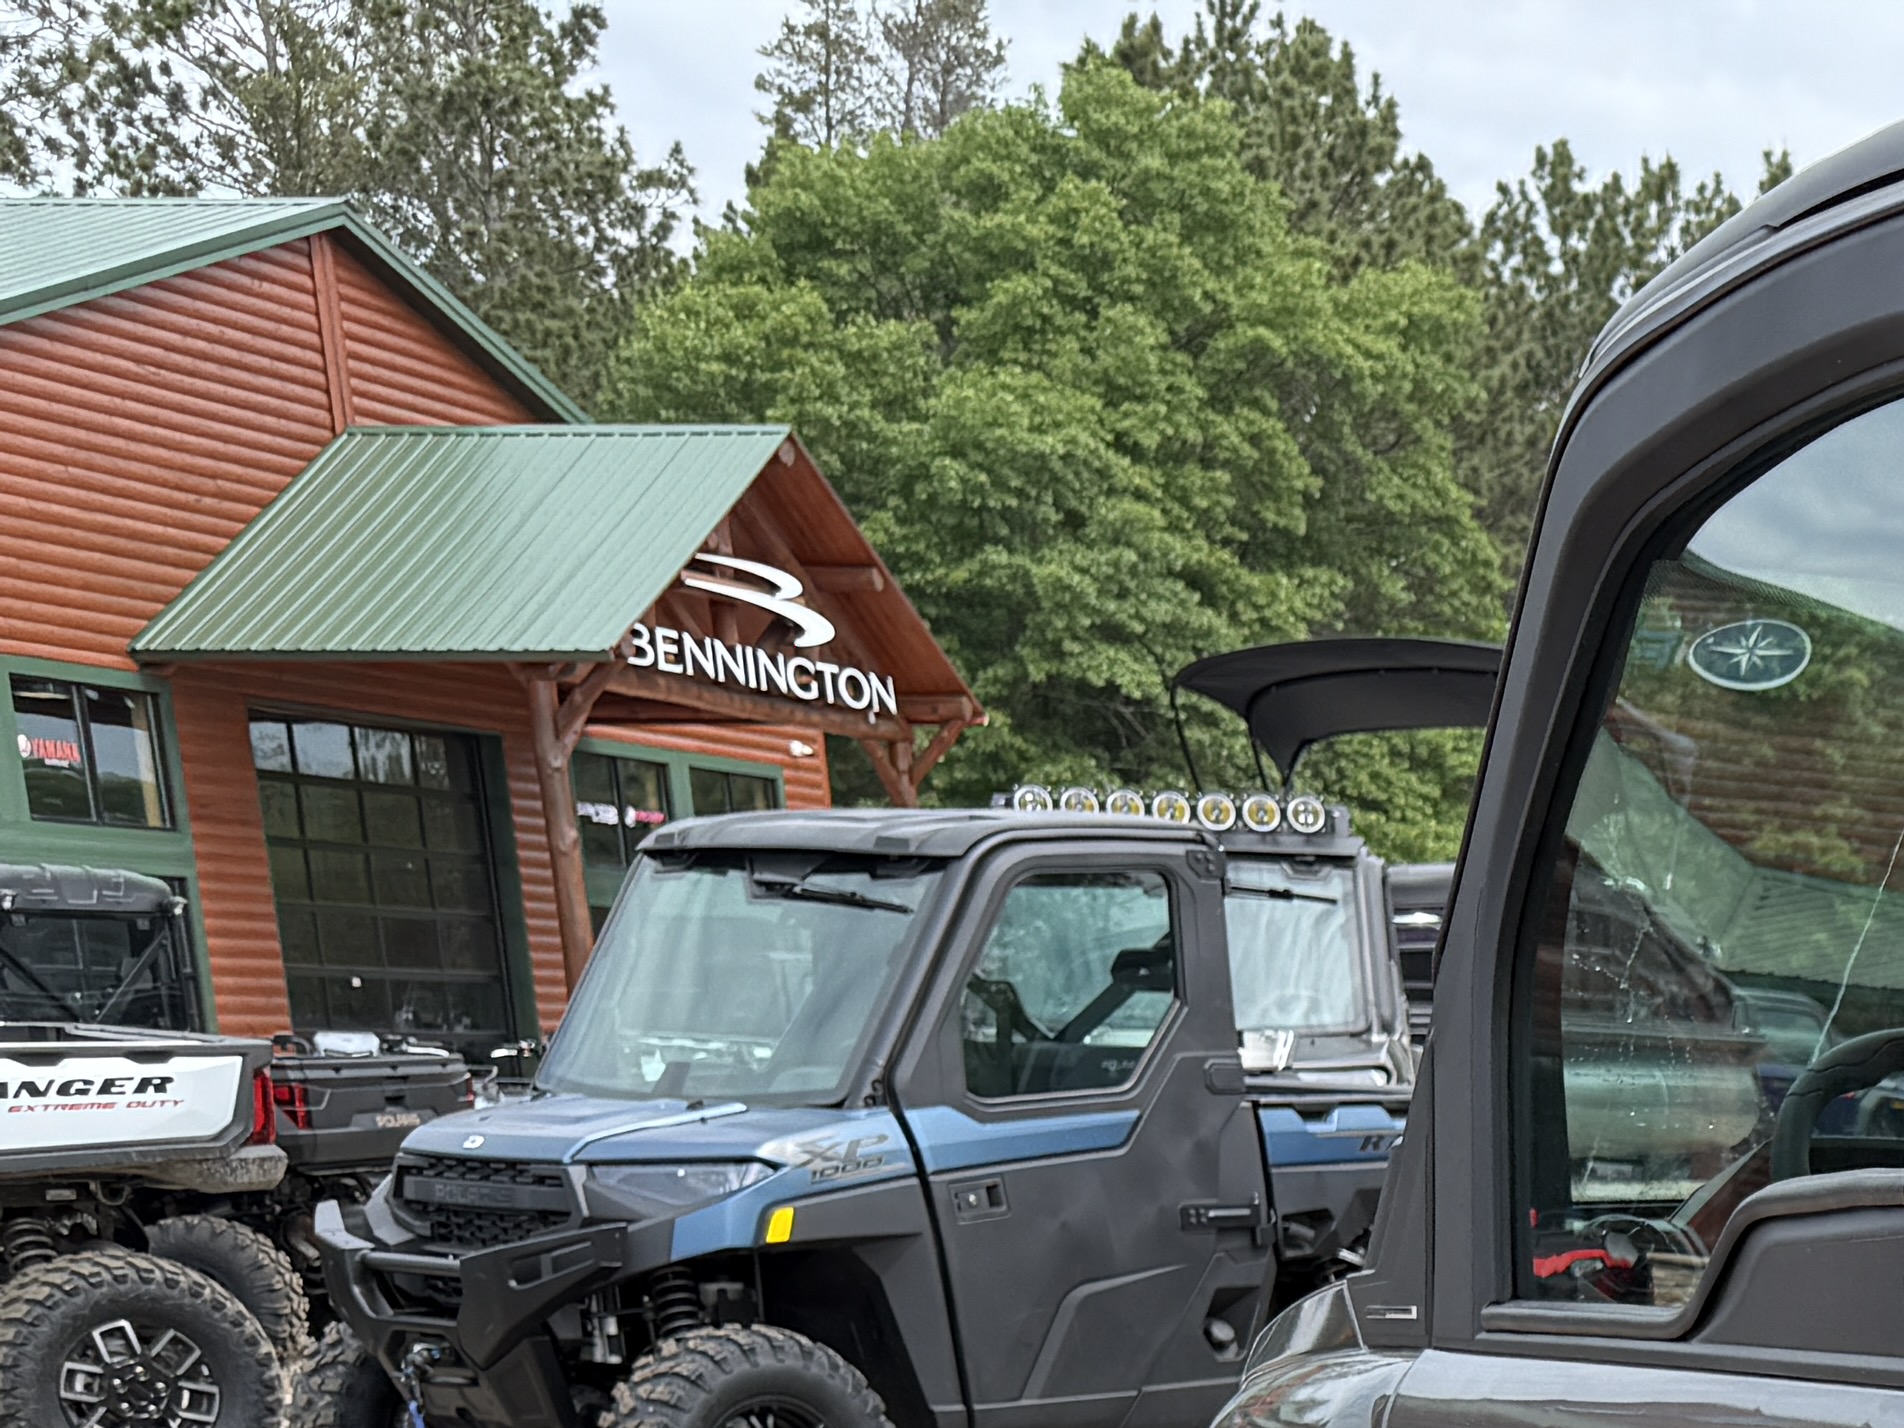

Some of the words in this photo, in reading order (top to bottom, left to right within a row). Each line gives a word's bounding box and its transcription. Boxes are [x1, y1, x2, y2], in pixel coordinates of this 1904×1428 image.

[626, 621, 898, 716] BENNINGTON
[0, 1076, 175, 1099] NGER
[7, 1101, 118, 1114] EXTREME
[125, 1098, 185, 1110] DUTY
[791, 1133, 889, 1169] XP
[811, 1155, 884, 1184] 1000
